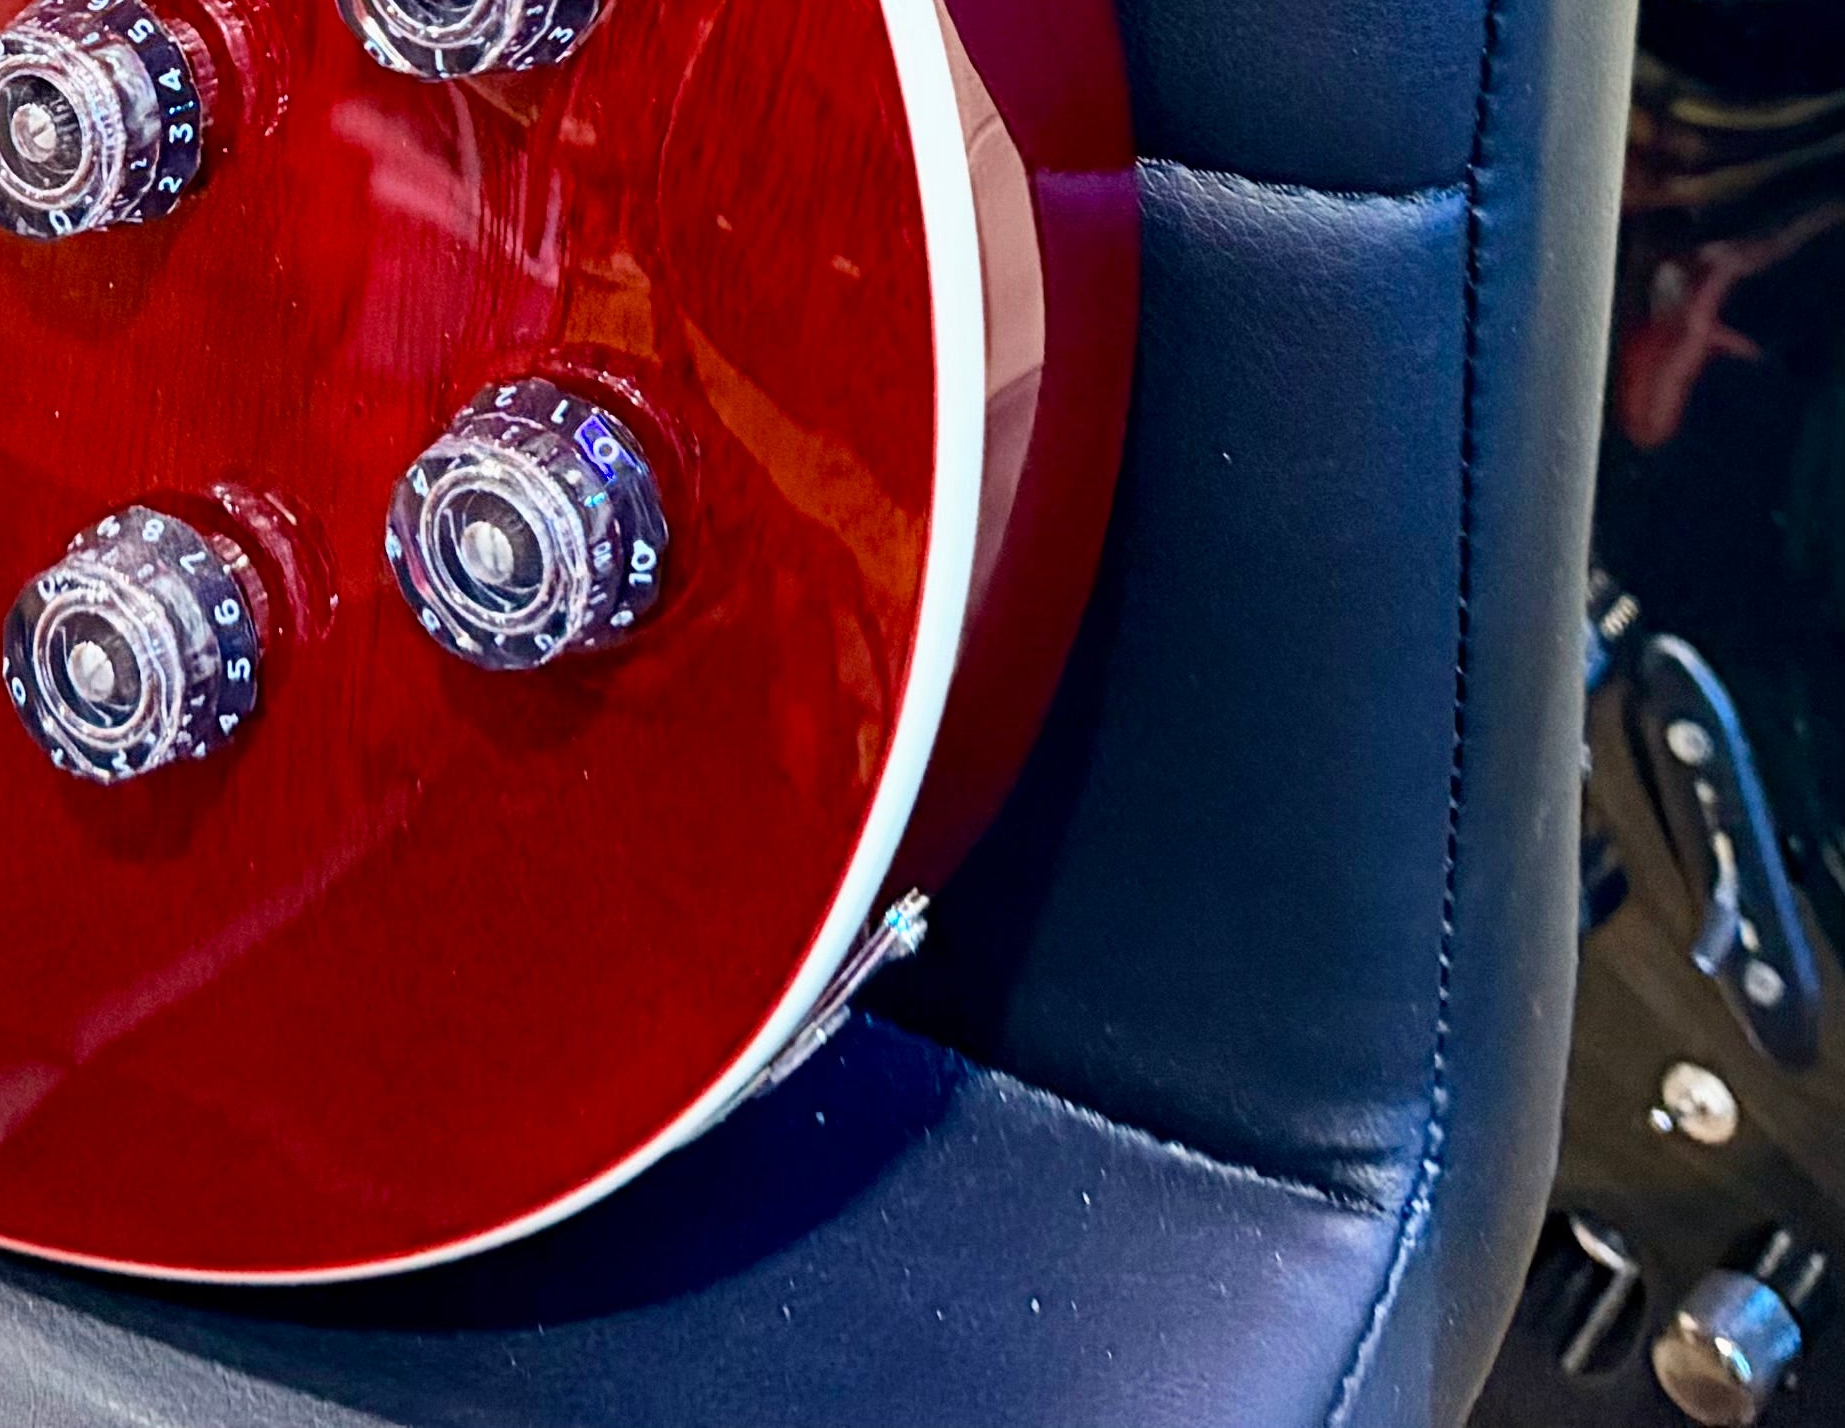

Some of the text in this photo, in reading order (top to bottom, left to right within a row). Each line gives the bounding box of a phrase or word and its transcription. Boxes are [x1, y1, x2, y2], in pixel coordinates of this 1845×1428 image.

[127, 17, 155, 44] 5
[158, 67, 182, 92] 4
[168, 122, 194, 145] 3
[158, 175, 184, 195] 2
[227, 656, 252, 682] 5
